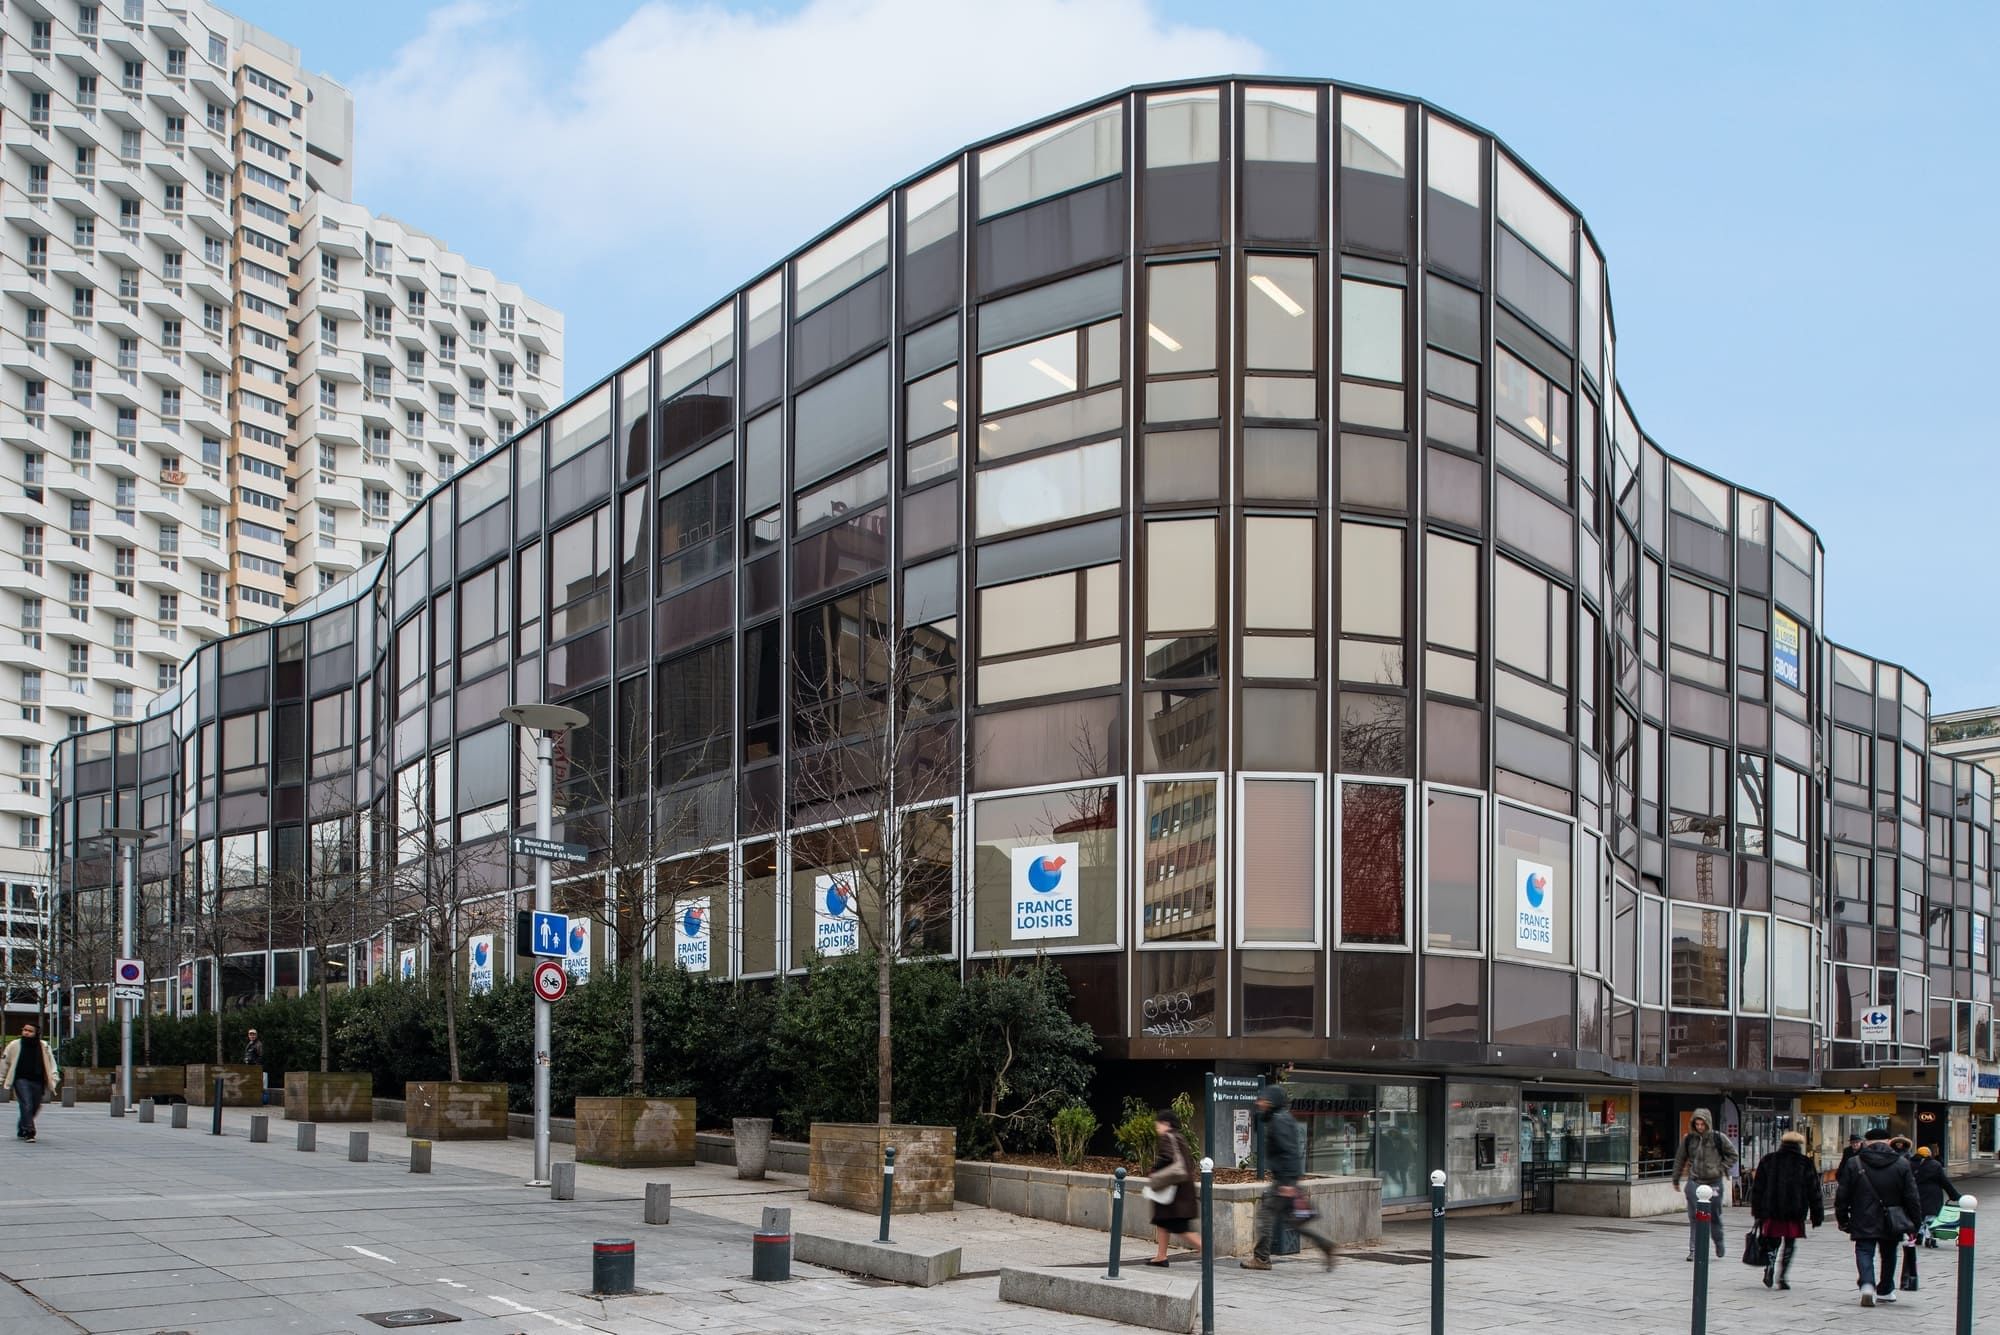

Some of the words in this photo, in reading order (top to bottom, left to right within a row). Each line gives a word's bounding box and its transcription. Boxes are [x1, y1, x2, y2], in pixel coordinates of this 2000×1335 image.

[1017, 898, 1073, 914] FRANCE
[818, 919, 855, 934] FRANCE
[1017, 914, 1073, 929] LOISIRS
[1519, 912, 1550, 929] FRANCE
[818, 934, 855, 949] LOISIRS
[1519, 927, 1550, 943] LOISIRS
[677, 941, 707, 954] FRANCE
[1844, 1094, 1857, 1110] 3
